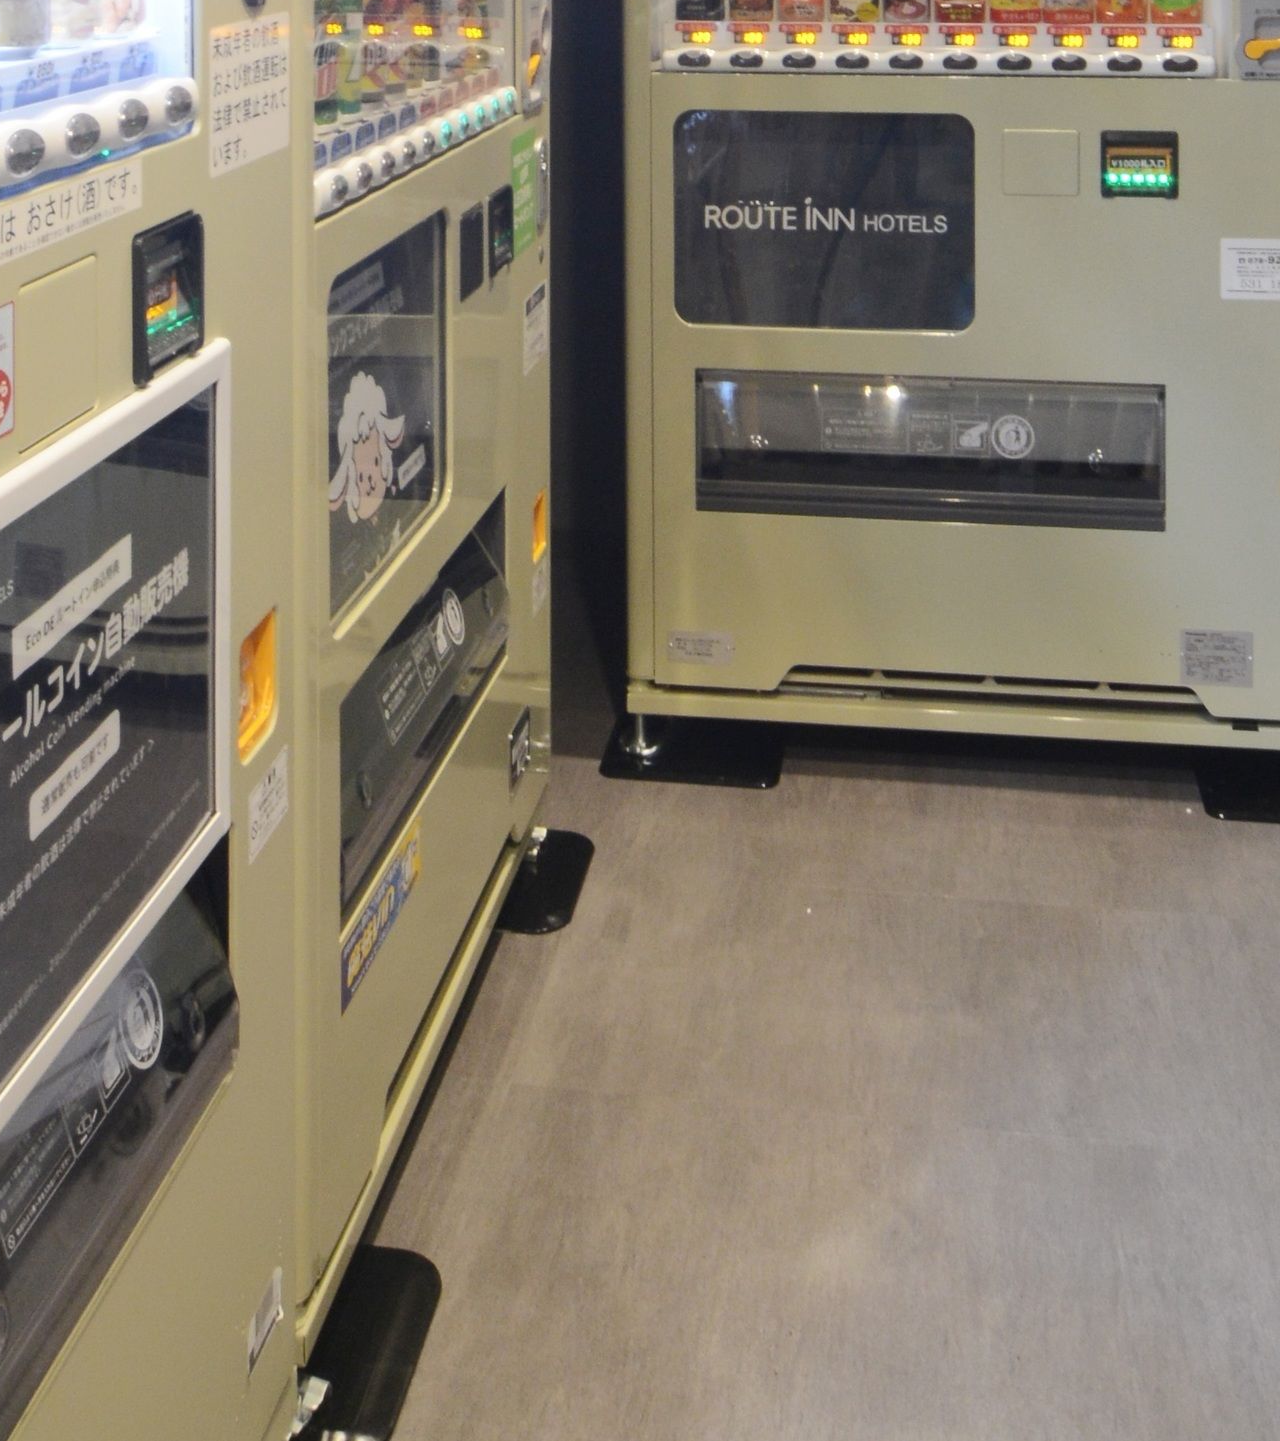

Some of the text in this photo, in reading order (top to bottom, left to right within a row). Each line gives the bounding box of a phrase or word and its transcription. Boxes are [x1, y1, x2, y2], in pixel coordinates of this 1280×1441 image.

[704, 203, 797, 231] ROUTE
[864, 214, 948, 234] HOTELS
[24, 630, 42, 653] Eco
[9, 744, 46, 789] Alcohol
[67, 690, 103, 729] Vending
